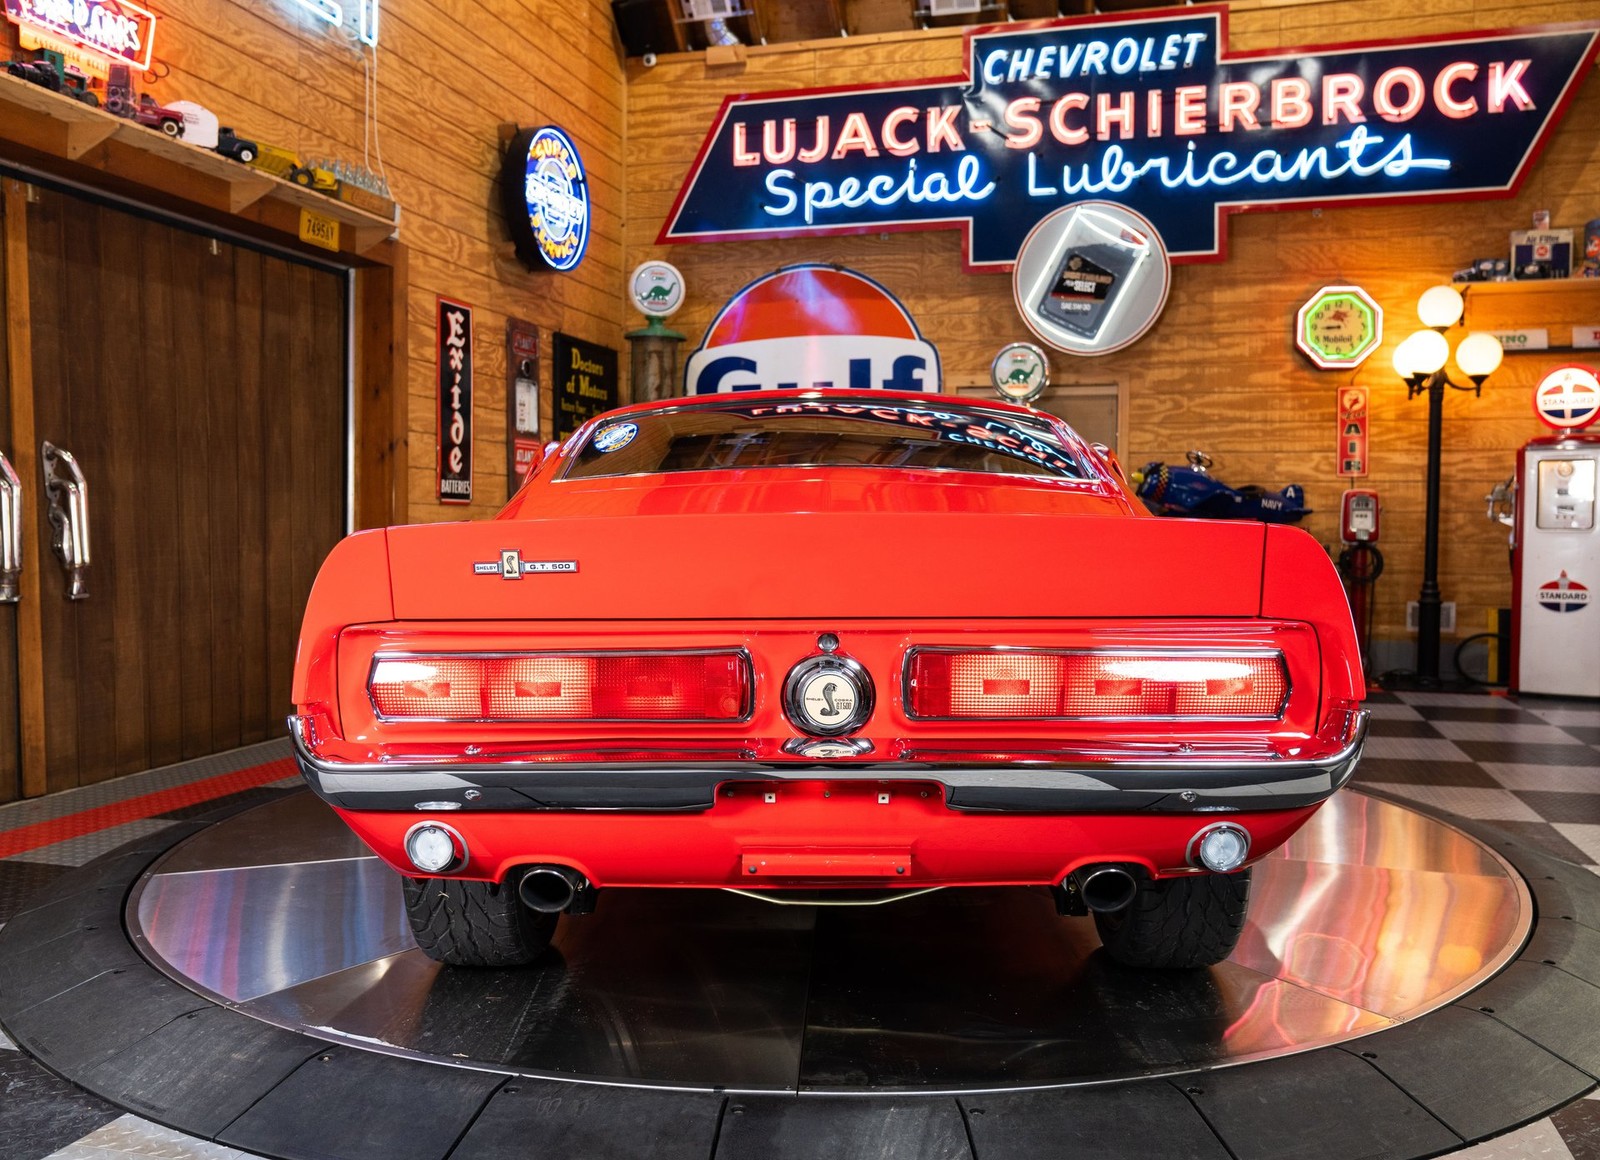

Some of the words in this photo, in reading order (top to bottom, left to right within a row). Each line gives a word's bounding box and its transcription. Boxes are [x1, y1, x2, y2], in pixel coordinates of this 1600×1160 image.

[983, 33, 1207, 84] CHEVROLET
[763, 154, 996, 224] Special
[1028, 125, 1451, 197] Lubricants
[571, 347, 604, 376] Doctors
[446, 310, 466, 474] Exide
[566, 374, 576, 394] of
[579, 374, 608, 400] Motors
[1343, 423, 1363, 473] AIR
[440, 479, 471, 495] BATTERIES
[1286, 487, 1296, 498] A
[1261, 498, 1283, 512] NAVY
[1540, 592, 1587, 600] STANDARD
